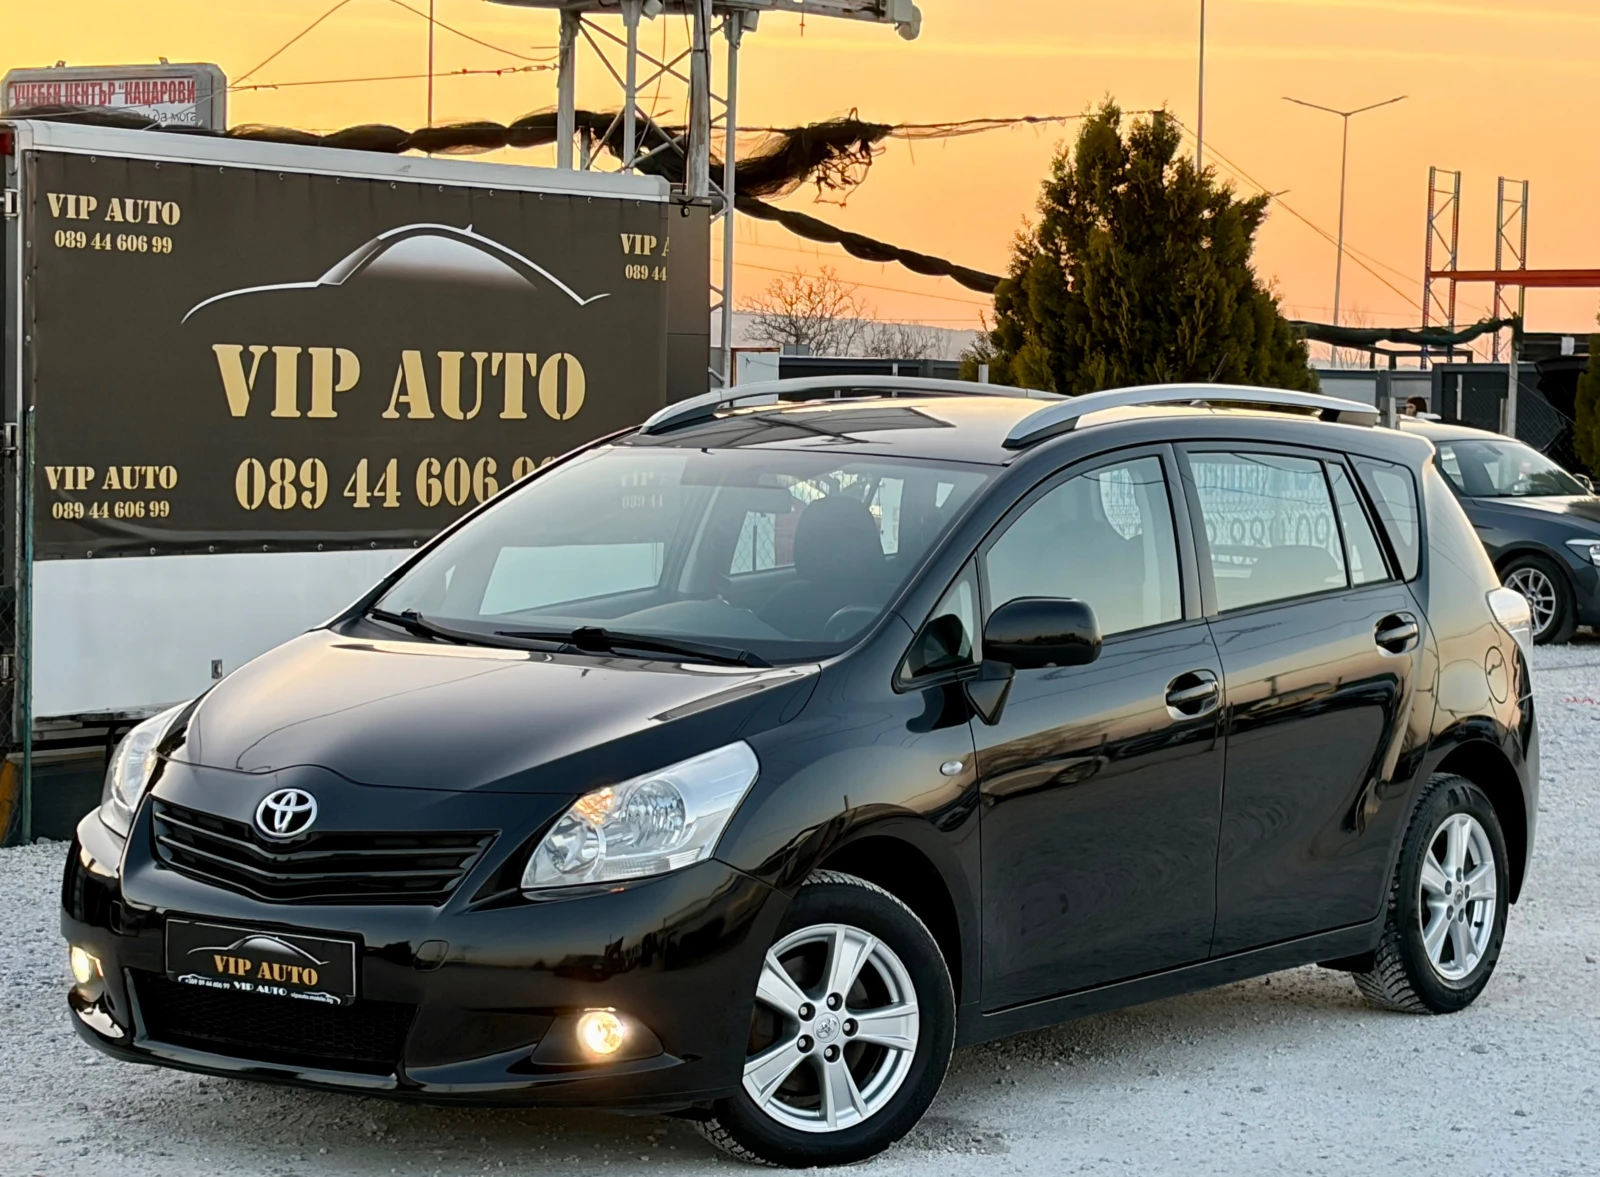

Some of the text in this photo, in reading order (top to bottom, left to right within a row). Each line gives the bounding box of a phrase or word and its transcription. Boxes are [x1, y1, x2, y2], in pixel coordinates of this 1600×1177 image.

[14, 82, 61, 105] УЧЕБЕН
[65, 81, 116, 106] ЦЕНТЪР
[46, 193, 181, 226] VIP AUTO
[54, 230, 173, 254] 089 44 606 99
[620, 233, 657, 255] VIP
[625, 264, 649, 280] 089
[212, 344, 586, 420] VIP AUTO
[44, 465, 178, 490] VIP AUTO
[235, 457, 328, 510] 089
[343, 458, 401, 508] 44
[416, 457, 499, 508] 606
[52, 500, 170, 519] 089 44 606 99
[213, 954, 318, 986] VIP AUTO
[233, 981, 254, 991] VIP
[256, 985, 288, 997] AUTO
